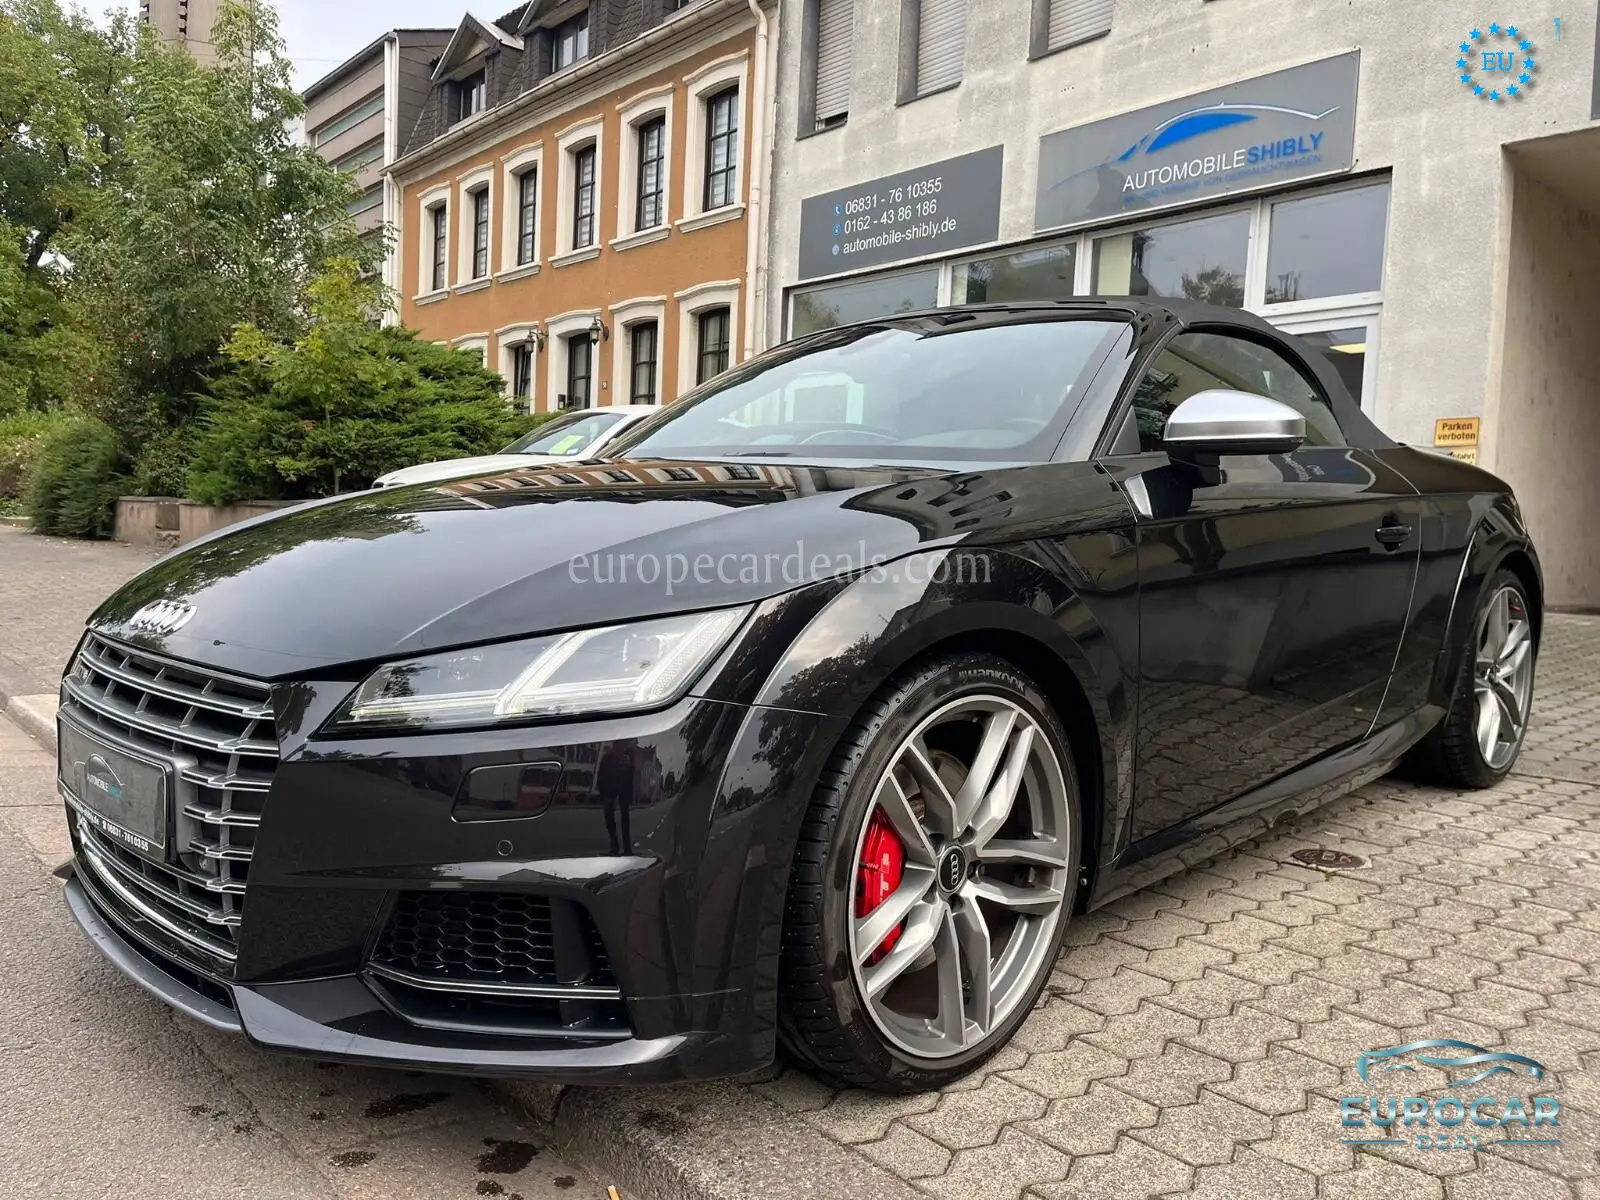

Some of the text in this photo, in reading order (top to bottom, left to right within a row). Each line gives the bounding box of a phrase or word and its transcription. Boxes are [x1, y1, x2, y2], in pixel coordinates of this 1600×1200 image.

[845, 194, 877, 215] 06831
[888, 187, 903, 203] 76
[906, 177, 942, 199] 10355
[844, 215, 870, 234] 0162
[880, 210, 894, 225] 43
[897, 205, 912, 221] 86
[916, 199, 937, 217] 186
[842, 217, 957, 254] automobile-shibly.de
[1437, 432, 1476, 440] verboten
[1442, 422, 1473, 431] Parken
